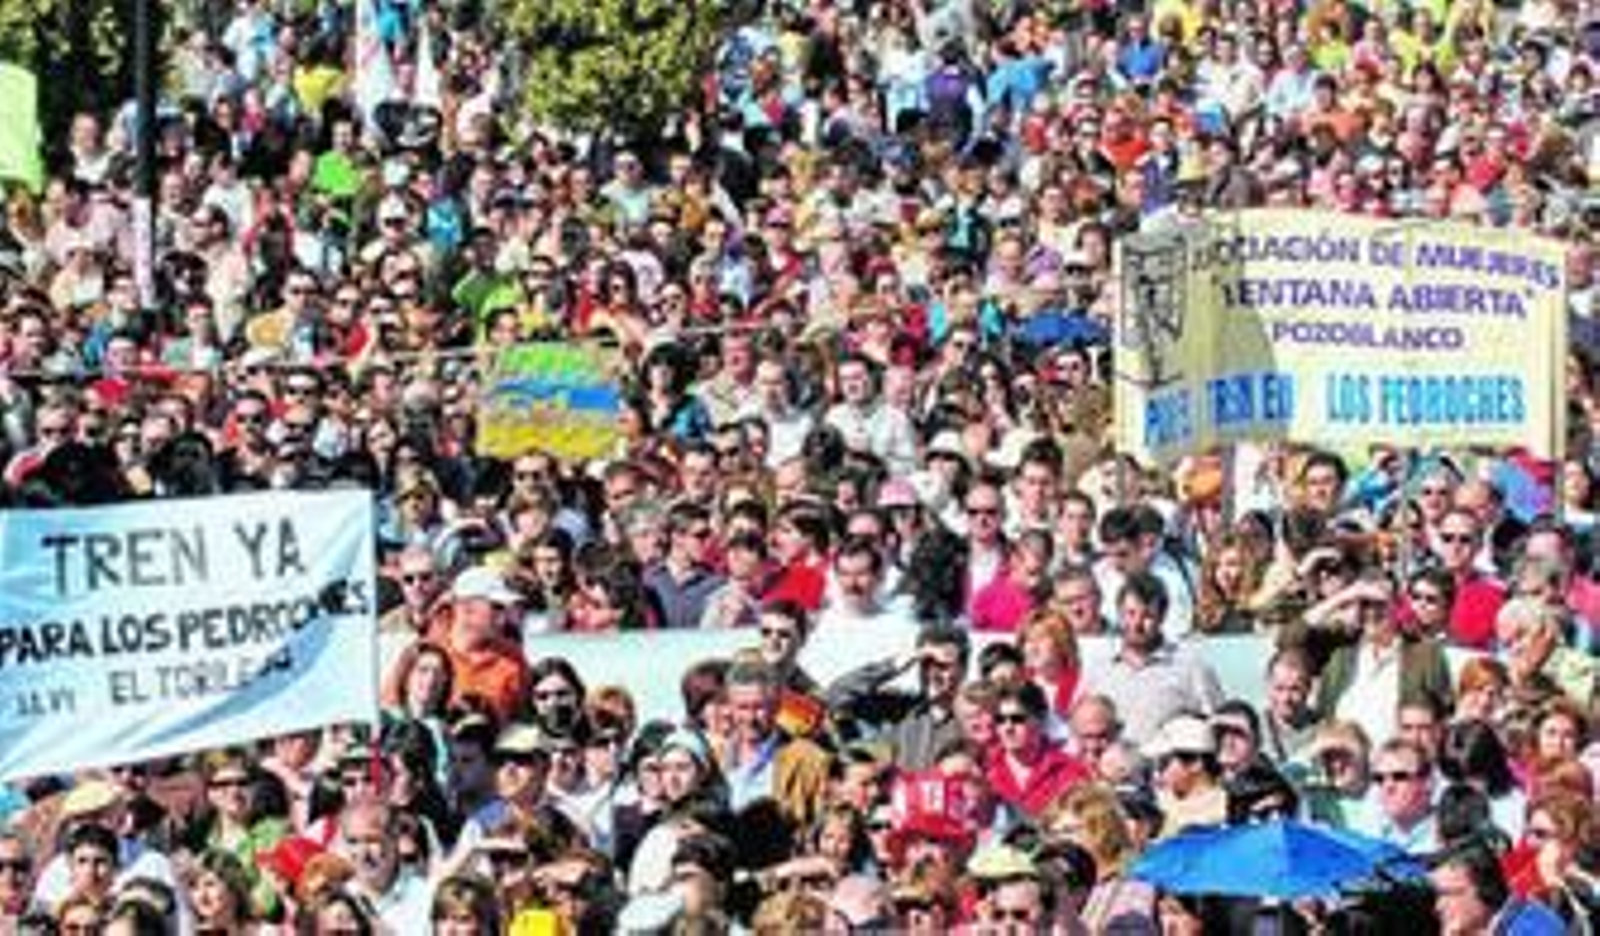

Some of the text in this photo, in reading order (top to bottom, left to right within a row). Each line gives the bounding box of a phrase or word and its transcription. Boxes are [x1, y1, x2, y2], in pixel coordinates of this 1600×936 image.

[1370, 240, 1404, 268] DE
[1325, 372, 1371, 425] LOS
[41, 517, 307, 597] TREN YA
[0, 621, 95, 667] PARA
[101, 613, 171, 654] LOS
[110, 670, 148, 706] EL
